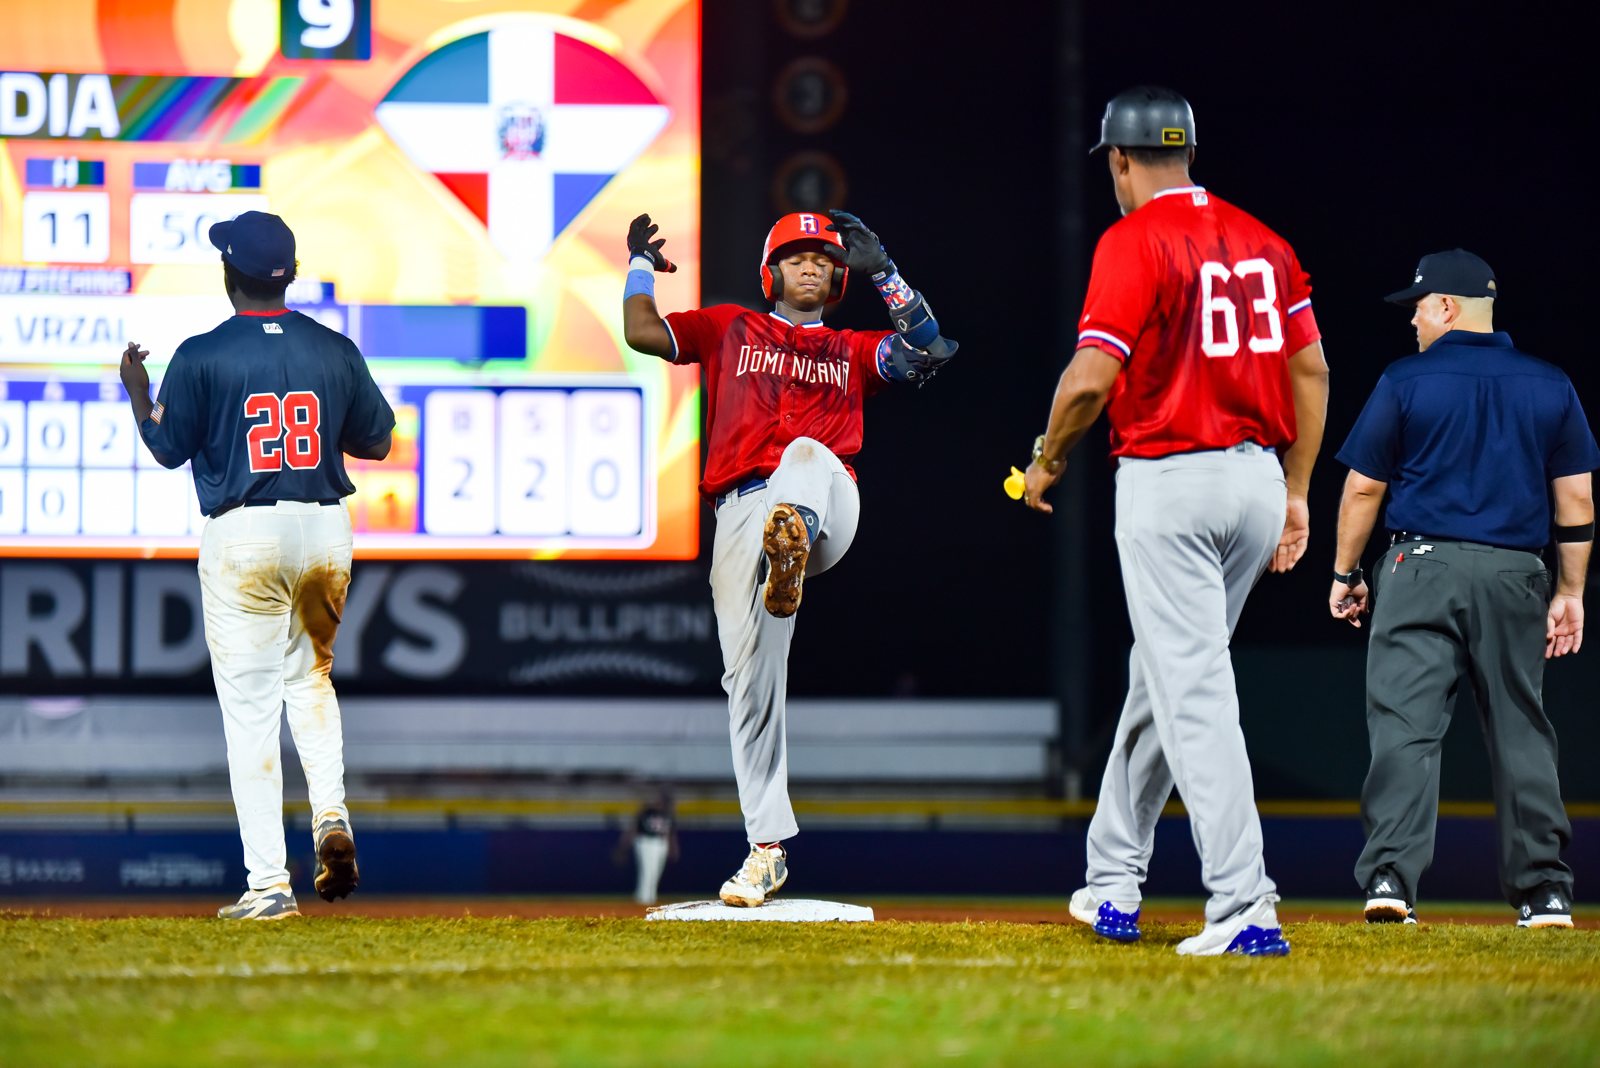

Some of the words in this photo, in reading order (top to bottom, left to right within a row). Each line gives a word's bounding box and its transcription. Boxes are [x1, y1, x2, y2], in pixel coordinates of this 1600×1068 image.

[299, 0, 354, 48] 9
[1, 72, 120, 138] DIA
[52, 156, 79, 188] H
[164, 158, 233, 192] AVG
[40, 210, 92, 250] 11
[1200, 257, 1284, 357] 63
[244, 391, 320, 473] 28
[450, 456, 474, 501] 2
[522, 456, 547, 501] 2
[1, 566, 467, 679] RIDYS
[501, 603, 710, 642] BULLPEN
